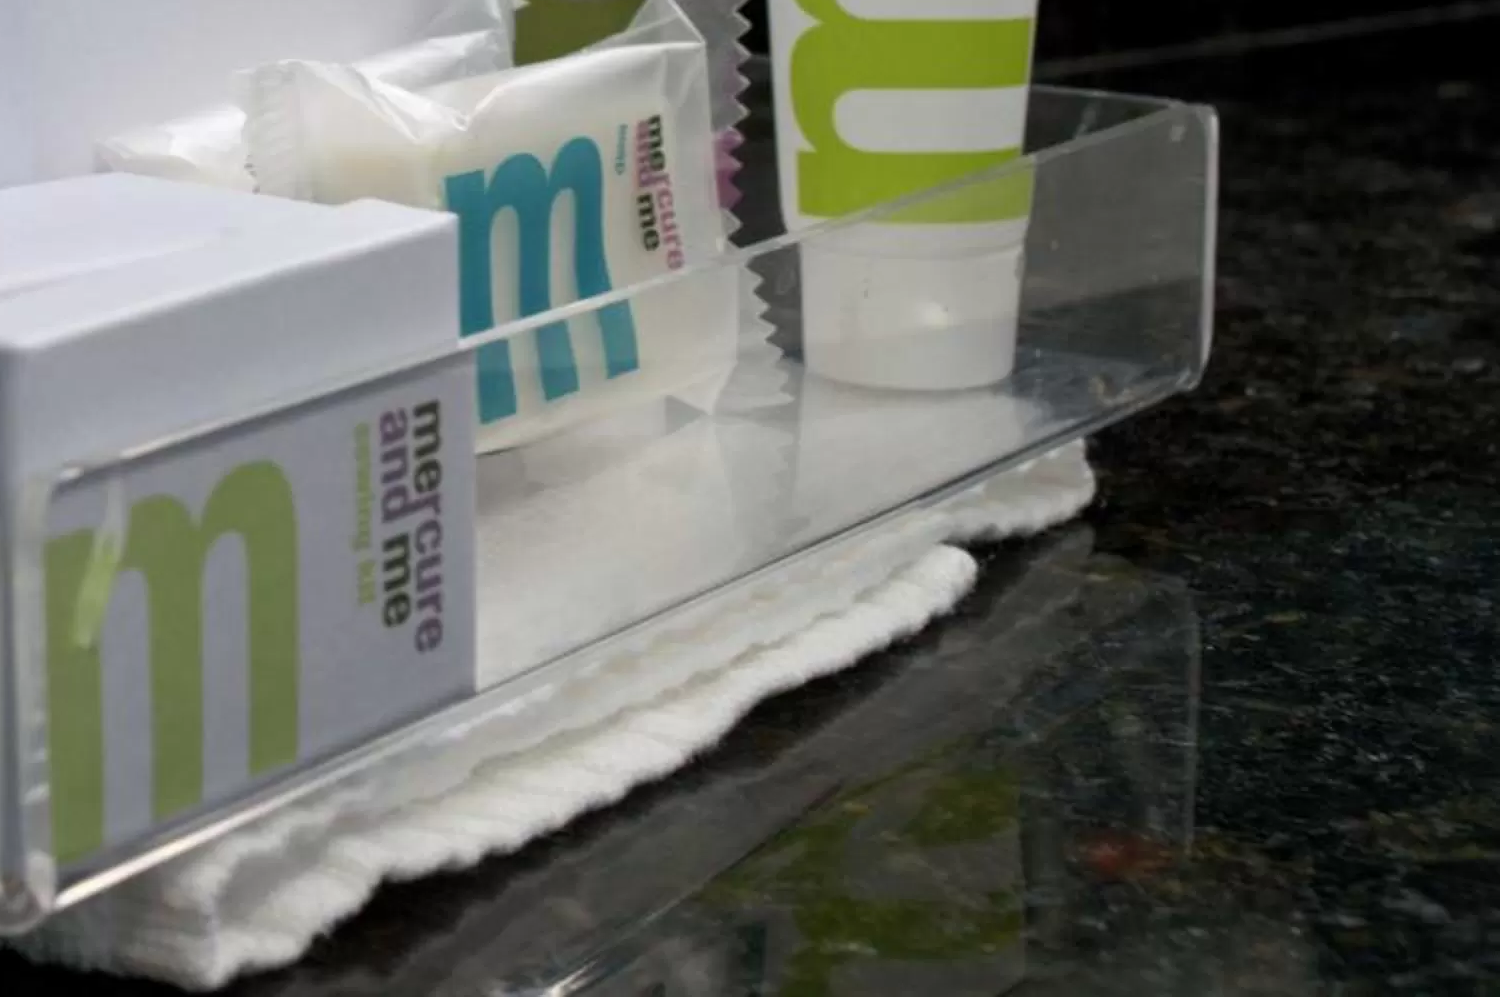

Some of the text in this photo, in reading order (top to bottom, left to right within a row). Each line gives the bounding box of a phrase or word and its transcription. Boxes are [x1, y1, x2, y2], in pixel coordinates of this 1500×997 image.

[637, 192, 660, 252] me
[649, 114, 684, 270] mercure
[379, 406, 412, 628] and me
[413, 399, 443, 654] mercure
